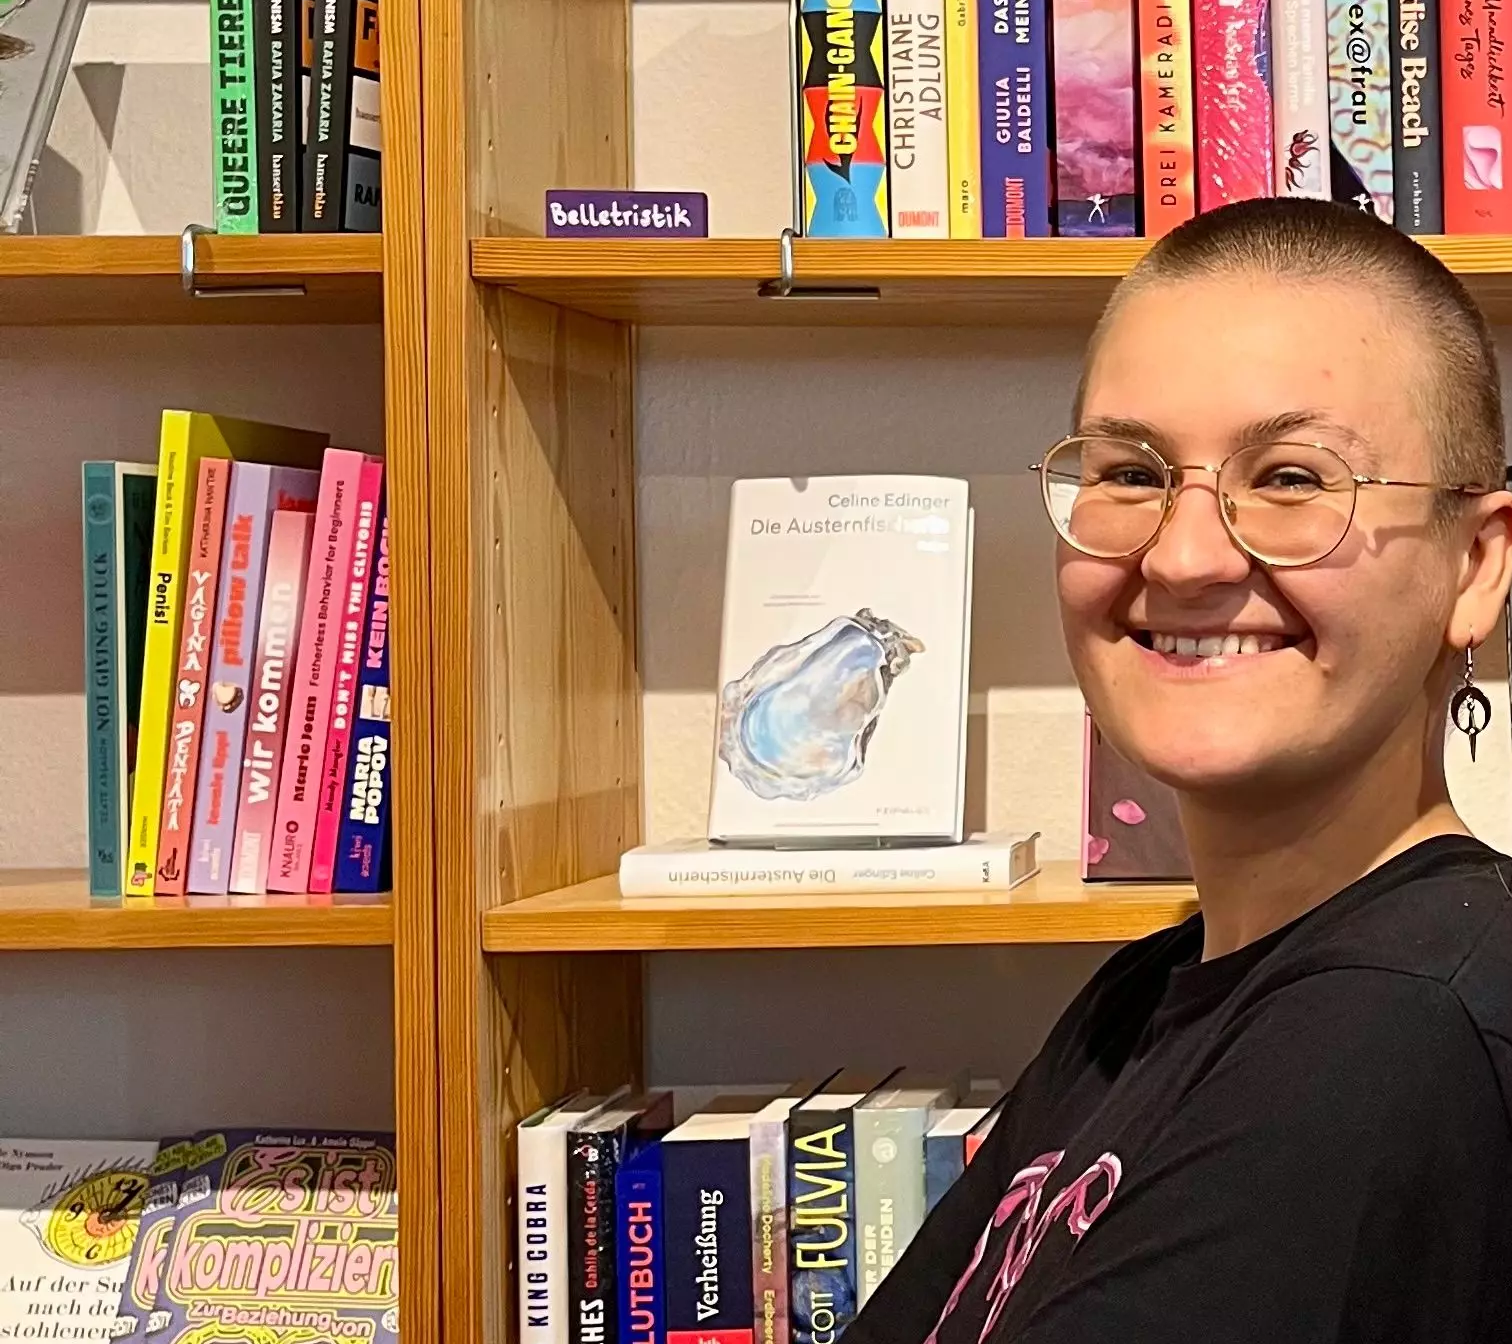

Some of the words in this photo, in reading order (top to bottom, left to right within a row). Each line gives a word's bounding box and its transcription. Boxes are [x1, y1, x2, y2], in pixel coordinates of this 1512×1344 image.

[271, 41, 283, 79] RAFIA
[890, 13, 915, 170] CHRISTIANE
[917, 13, 943, 121] ADLUNG
[1346, 3, 1373, 126] ex@frau
[1400, 56, 1429, 149] Beach
[272, 83, 284, 143] ZAKARIA
[996, 76, 1011, 144] GIULIA
[1017, 67, 1033, 153] BALDELLI
[221, 97, 250, 216] QUEERE
[1161, 150, 1176, 206] DREI
[550, 201, 692, 228] Belletristik
[328, 480, 346, 542] Beginners
[828, 492, 880, 509] Celine
[884, 492, 951, 512] Edinger
[325, 545, 338, 562] for
[252, 581, 293, 733] kommen
[309, 622, 329, 687] Fatherless
[243, 736, 272, 804] wir
[349, 736, 374, 821] MARIA
[365, 734, 388, 825] POPOV
[796, 1122, 848, 1270] FULVIA
[695, 1189, 724, 1323] Verheißung
